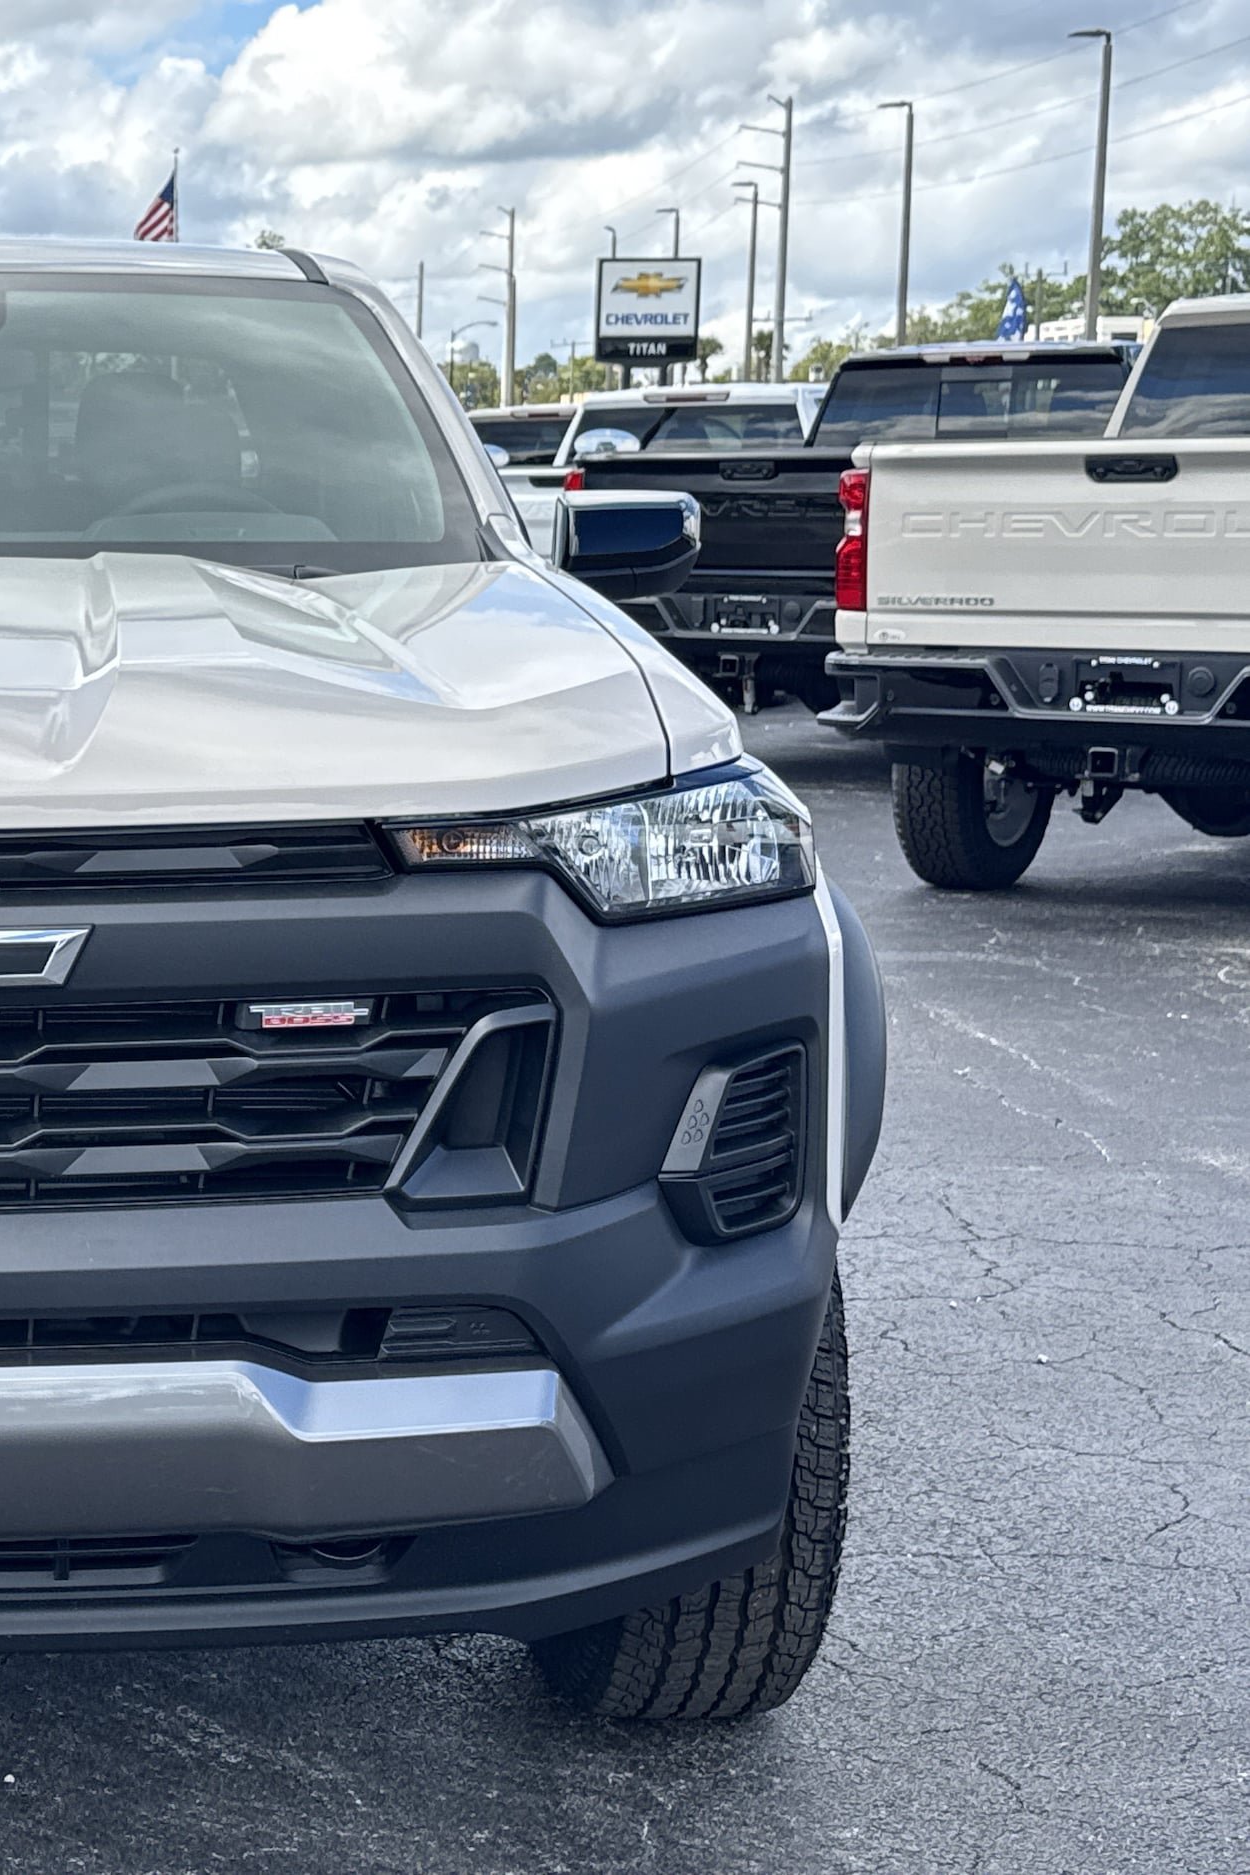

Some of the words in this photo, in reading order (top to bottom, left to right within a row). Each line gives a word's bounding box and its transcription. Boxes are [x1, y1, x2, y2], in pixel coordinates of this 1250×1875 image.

[605, 312, 690, 326] CHEVROLET
[627, 342, 668, 356] TITAN
[876, 595, 996, 607] SILVERADO
[249, 1002, 369, 1017] TRAIL
[262, 1014, 355, 1028] BOSS
